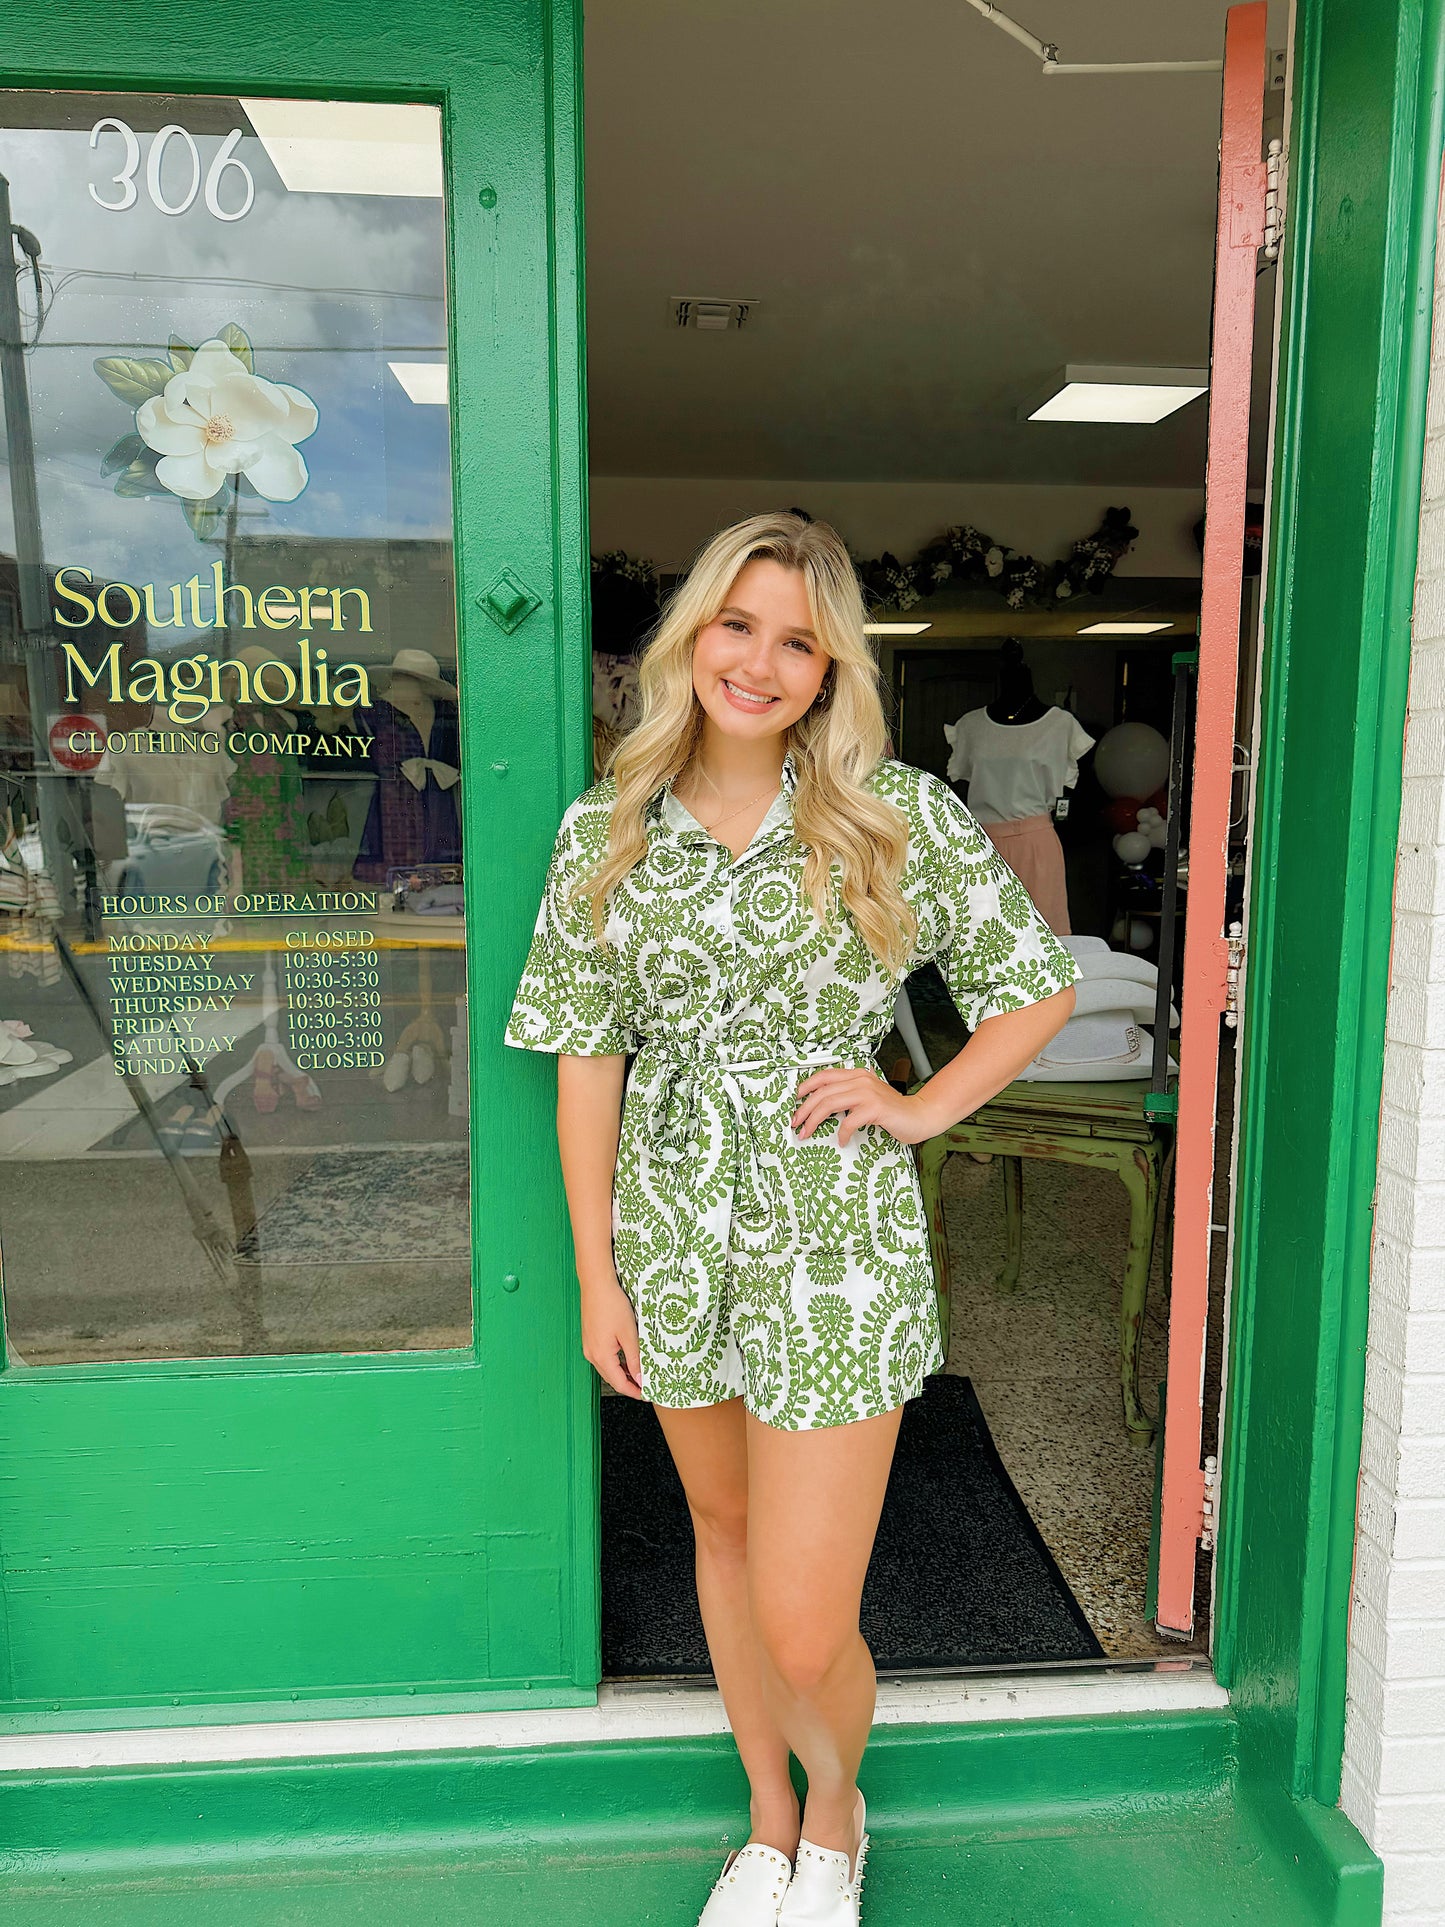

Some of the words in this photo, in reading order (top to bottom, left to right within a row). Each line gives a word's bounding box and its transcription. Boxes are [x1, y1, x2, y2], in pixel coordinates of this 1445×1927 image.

[88, 117, 255, 223] 306
[54, 560, 374, 633] Southern
[60, 638, 373, 725] Magnolia
[68, 731, 221, 755] CLOTHING
[228, 732, 375, 758] COMPANY
[102, 896, 188, 915] HOURS
[195, 895, 227, 913] OF
[233, 892, 378, 912] OPERATION
[109, 934, 212, 952] MONDAY
[285, 931, 375, 949] CLOSED
[108, 954, 215, 973] TUESDAY
[284, 950, 379, 969] 10:30-5:30
[109, 974, 255, 993] WEDNESDAY
[285, 971, 379, 989] 10:30-5:30
[110, 995, 235, 1014] THURSDAY
[287, 991, 381, 1009] 10:30-5:30
[111, 1016, 197, 1034] FRIDAY
[288, 1011, 382, 1029] 10:30-5:30
[113, 1035, 238, 1055] SATURDAY
[289, 1031, 384, 1050] 10:00-3:00
[114, 1056, 208, 1076] SUNDAY
[297, 1051, 385, 1070] CLOSED
